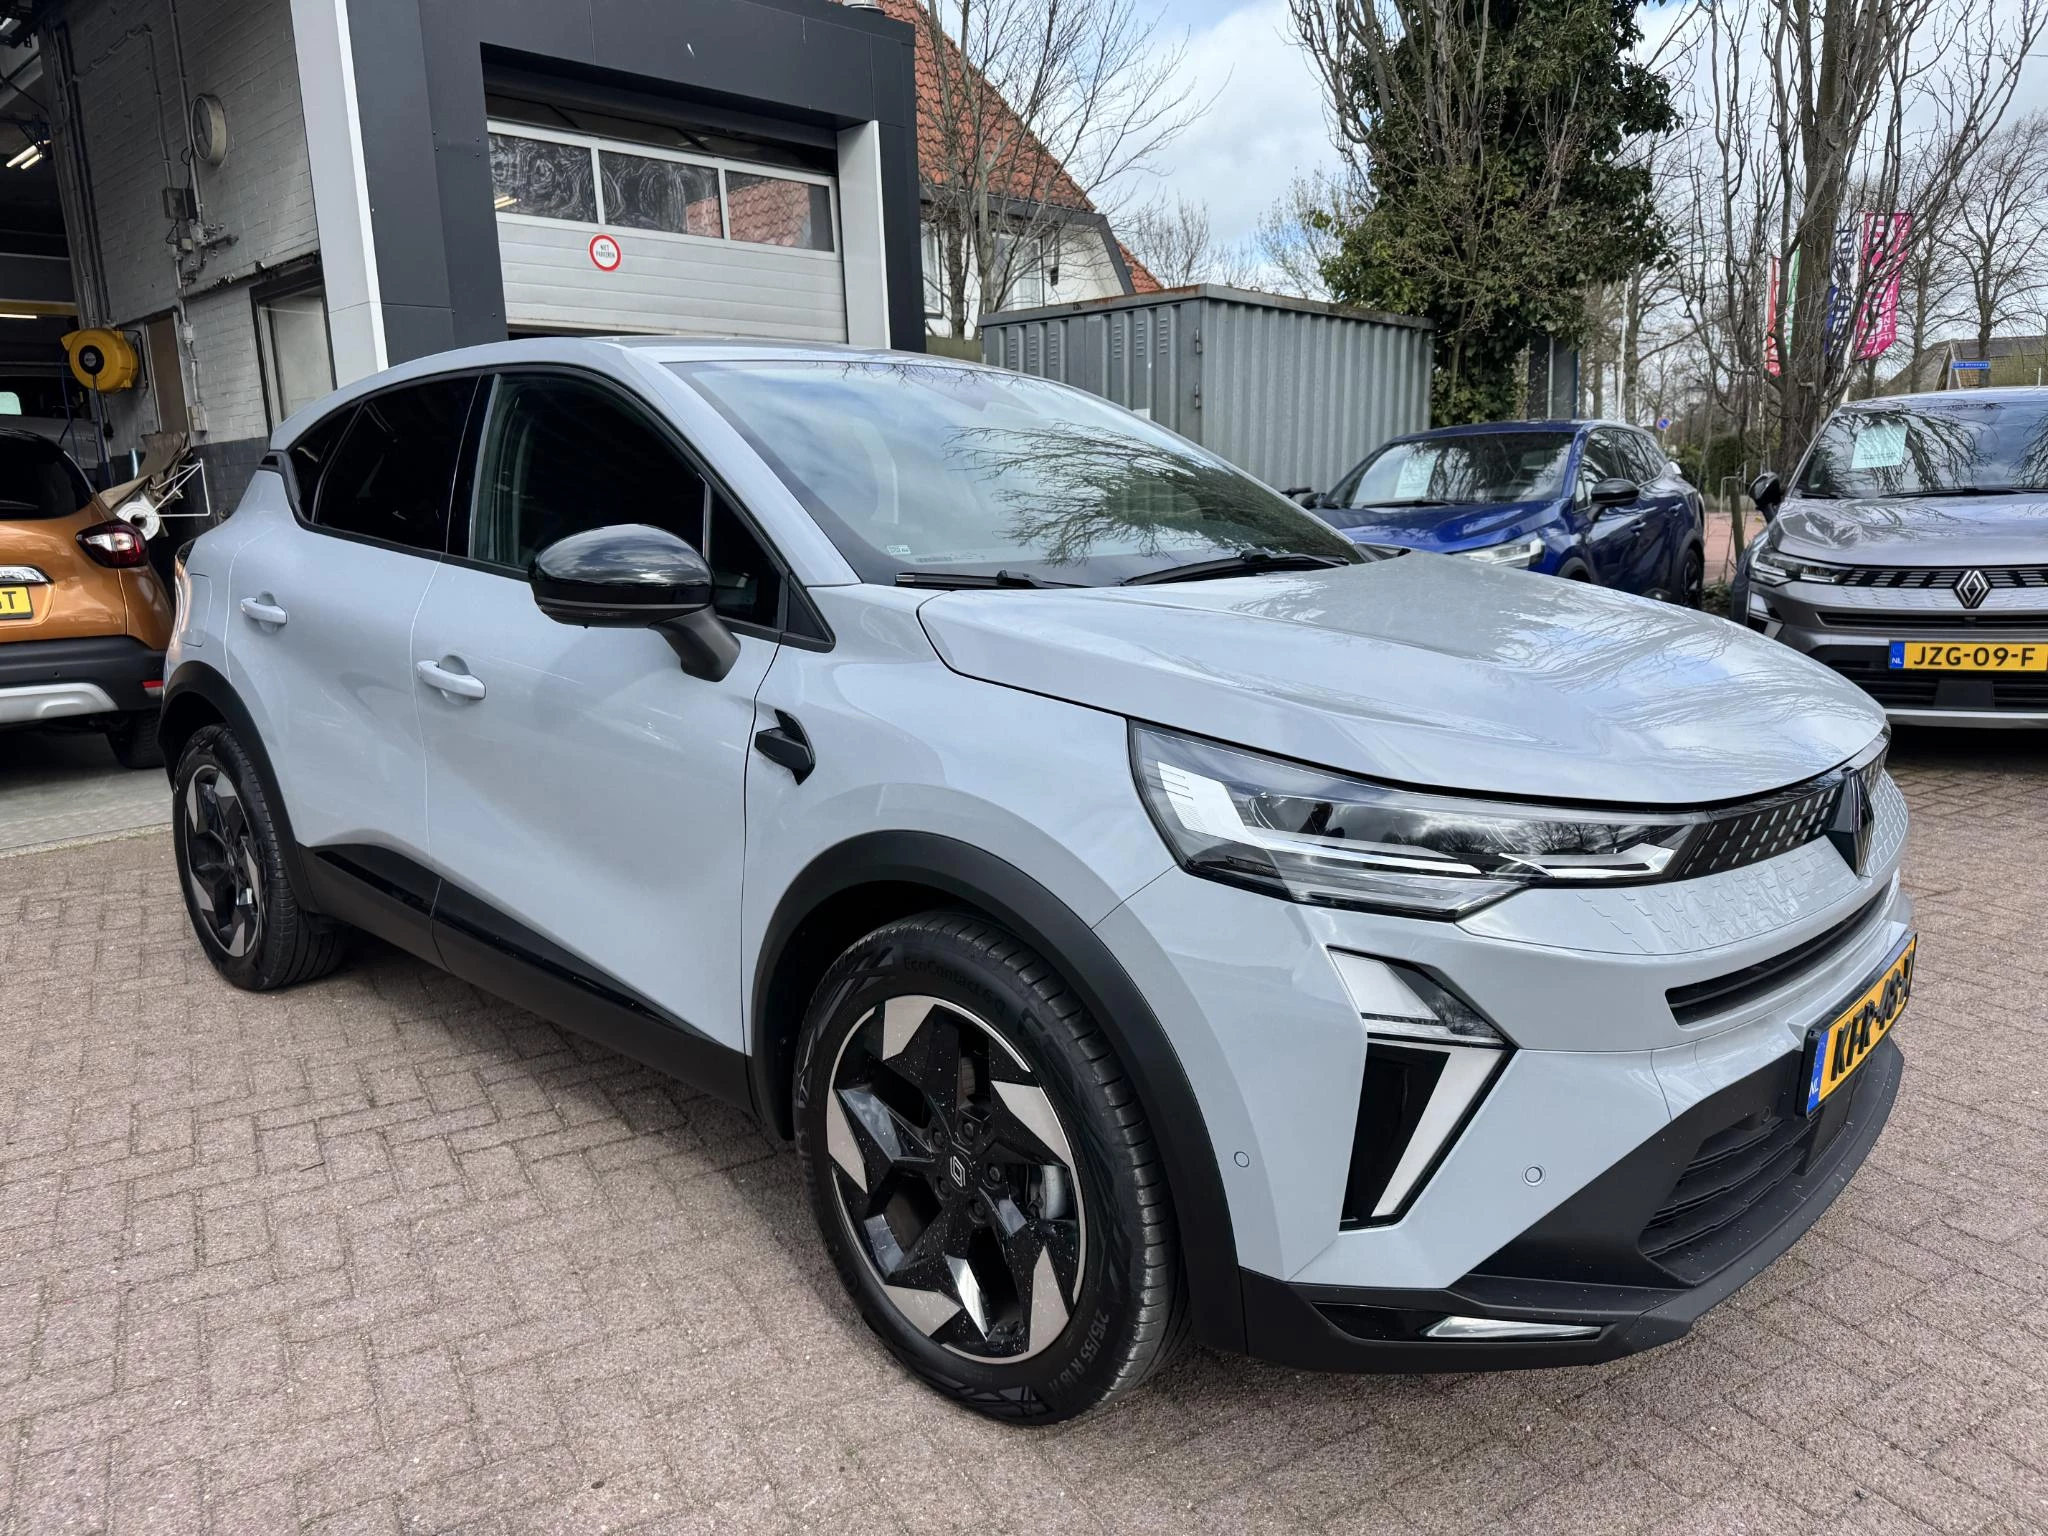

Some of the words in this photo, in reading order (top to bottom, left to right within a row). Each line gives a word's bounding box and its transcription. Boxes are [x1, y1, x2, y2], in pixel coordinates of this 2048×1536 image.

[0, 591, 16, 609] T
[1891, 657, 1902, 665] NL
[1913, 646, 2036, 667] JZG-09-F
[1080, 1307, 1110, 1363] 215/55
[1070, 1357, 1086, 1375] R
